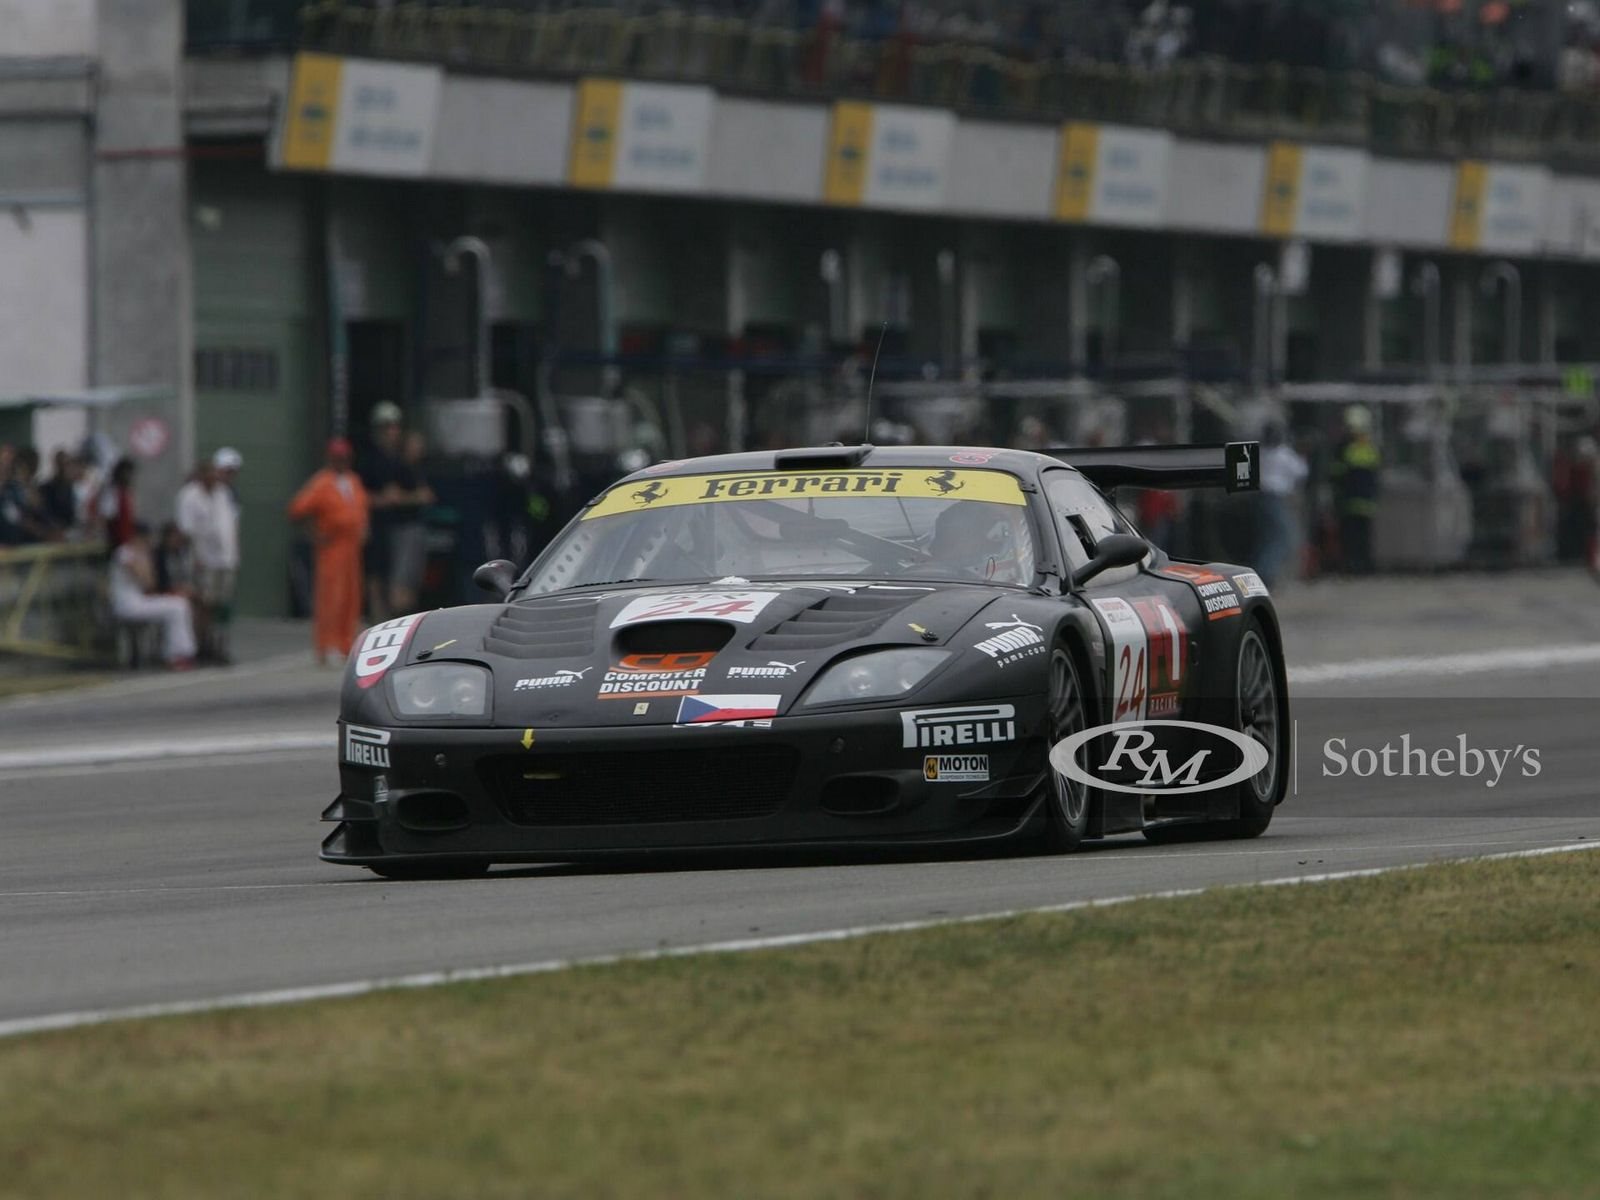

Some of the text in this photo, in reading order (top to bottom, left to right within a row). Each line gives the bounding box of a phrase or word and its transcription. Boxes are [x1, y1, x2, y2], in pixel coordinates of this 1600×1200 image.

[698, 472, 903, 499] Ferrari
[1198, 581, 1233, 597] COMPUTER
[626, 600, 754, 622] 24
[1204, 593, 1240, 613] DISCOUNT
[603, 667, 708, 682] COMPUTER
[727, 666, 788, 676] PUMA
[514, 675, 574, 688] PUMA
[599, 679, 704, 694] DISCOUNT
[1114, 644, 1146, 723] 24
[899, 703, 1016, 749] PIRELLI
[345, 724, 392, 769] PIRELLI
[939, 756, 988, 771] MOTON
